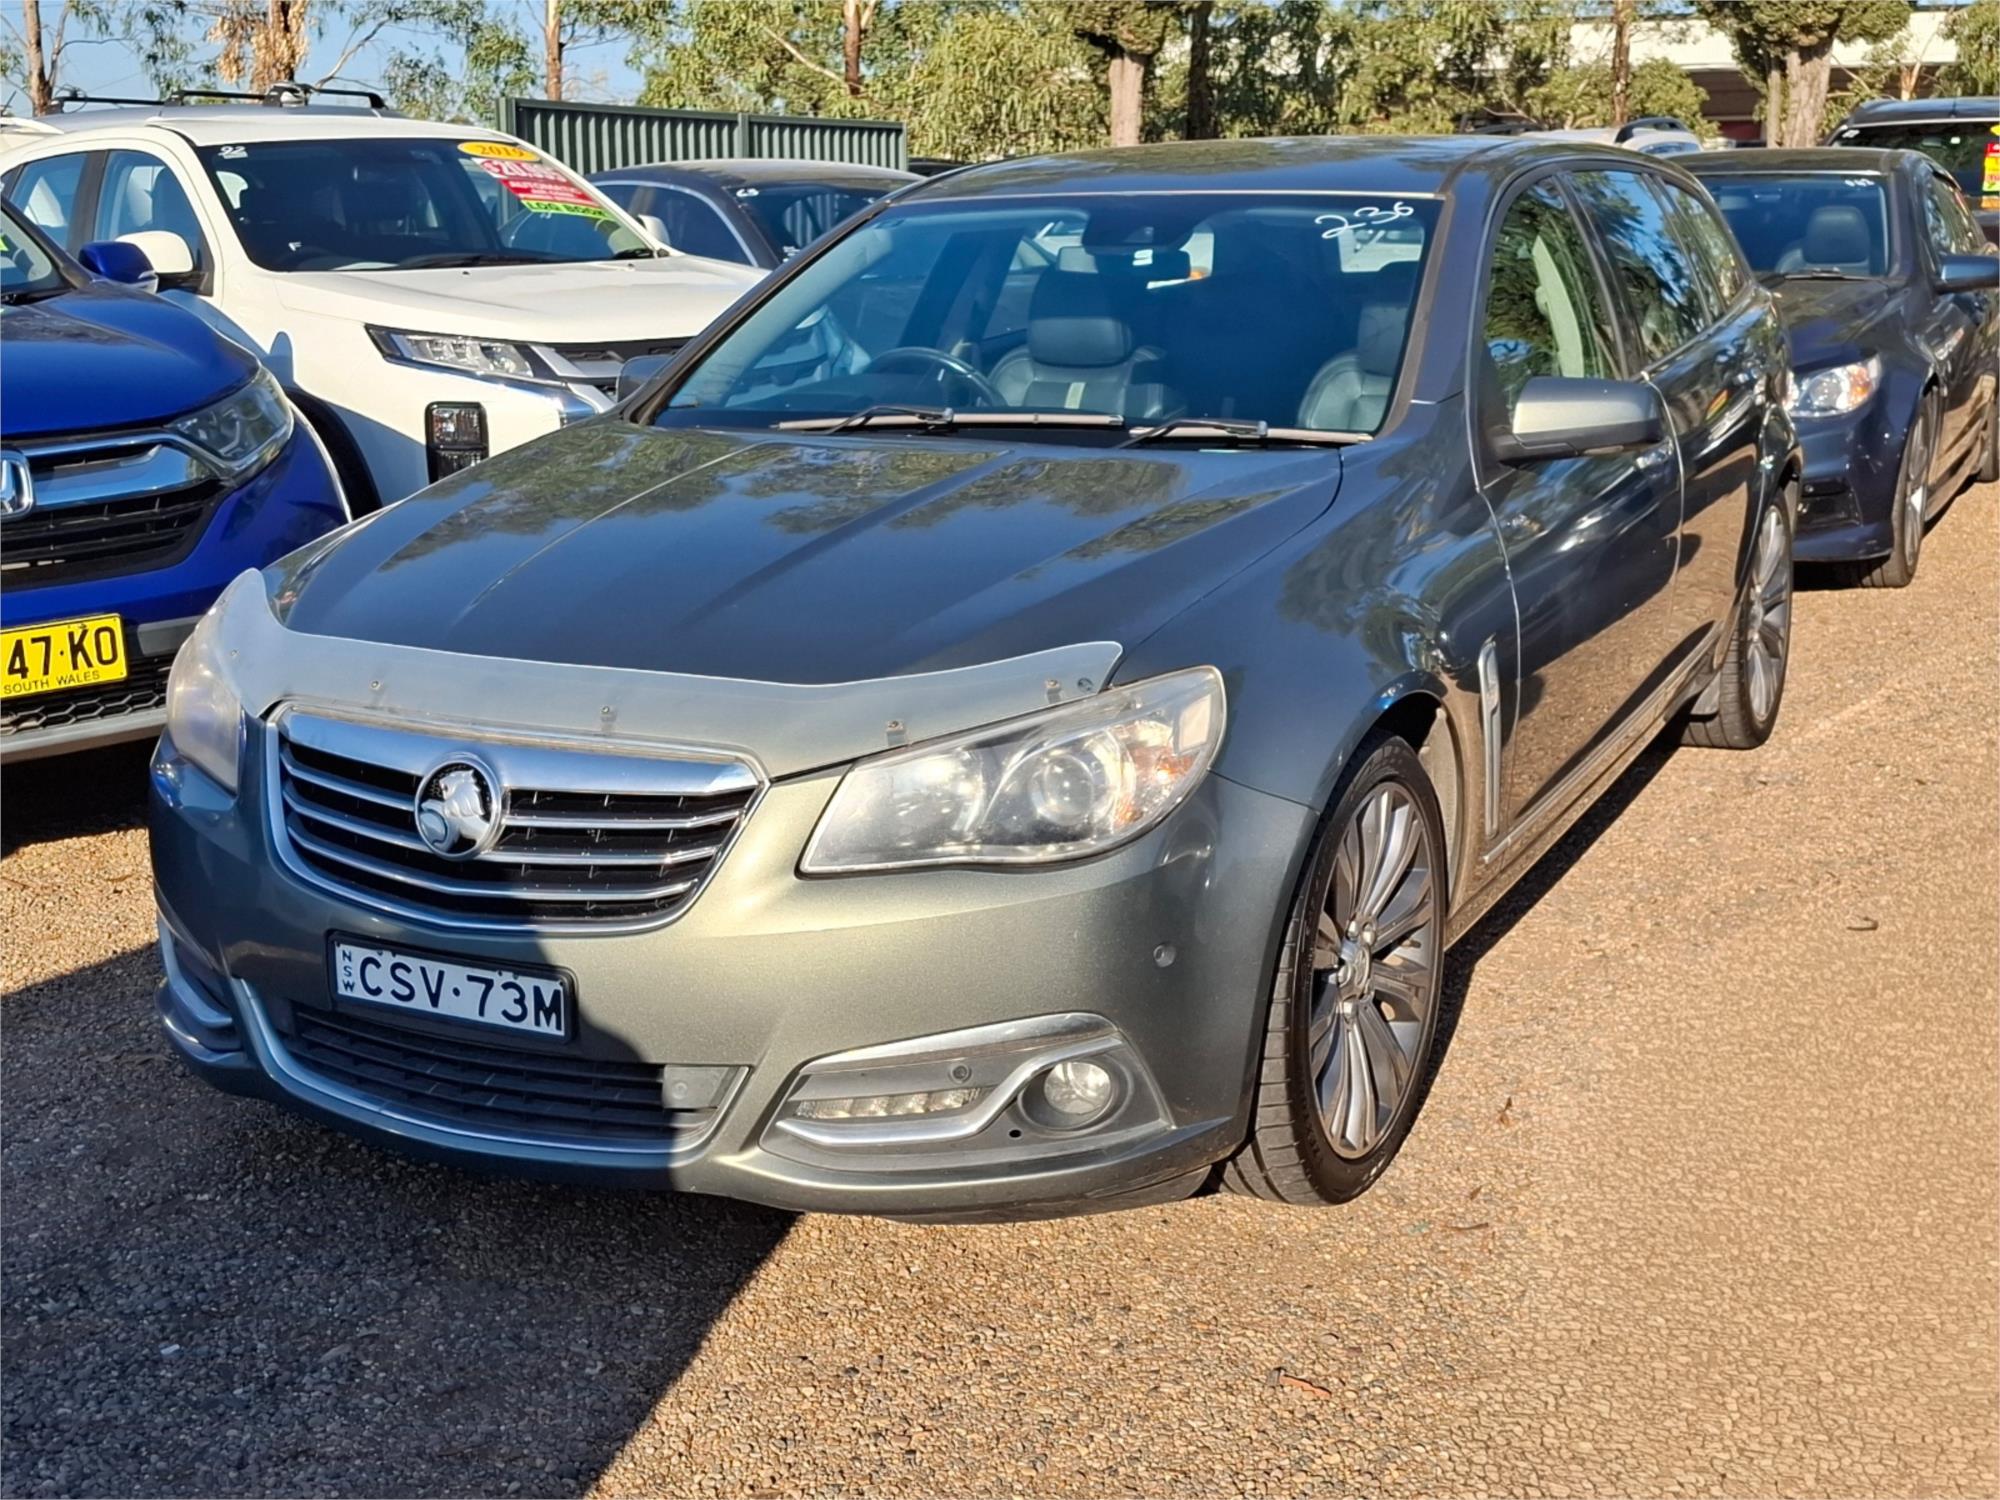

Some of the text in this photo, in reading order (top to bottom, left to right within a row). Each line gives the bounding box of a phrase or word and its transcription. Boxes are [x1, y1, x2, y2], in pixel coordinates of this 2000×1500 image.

[527, 201, 559, 211] LOG
[4, 670, 100, 694] SOUTH WALES
